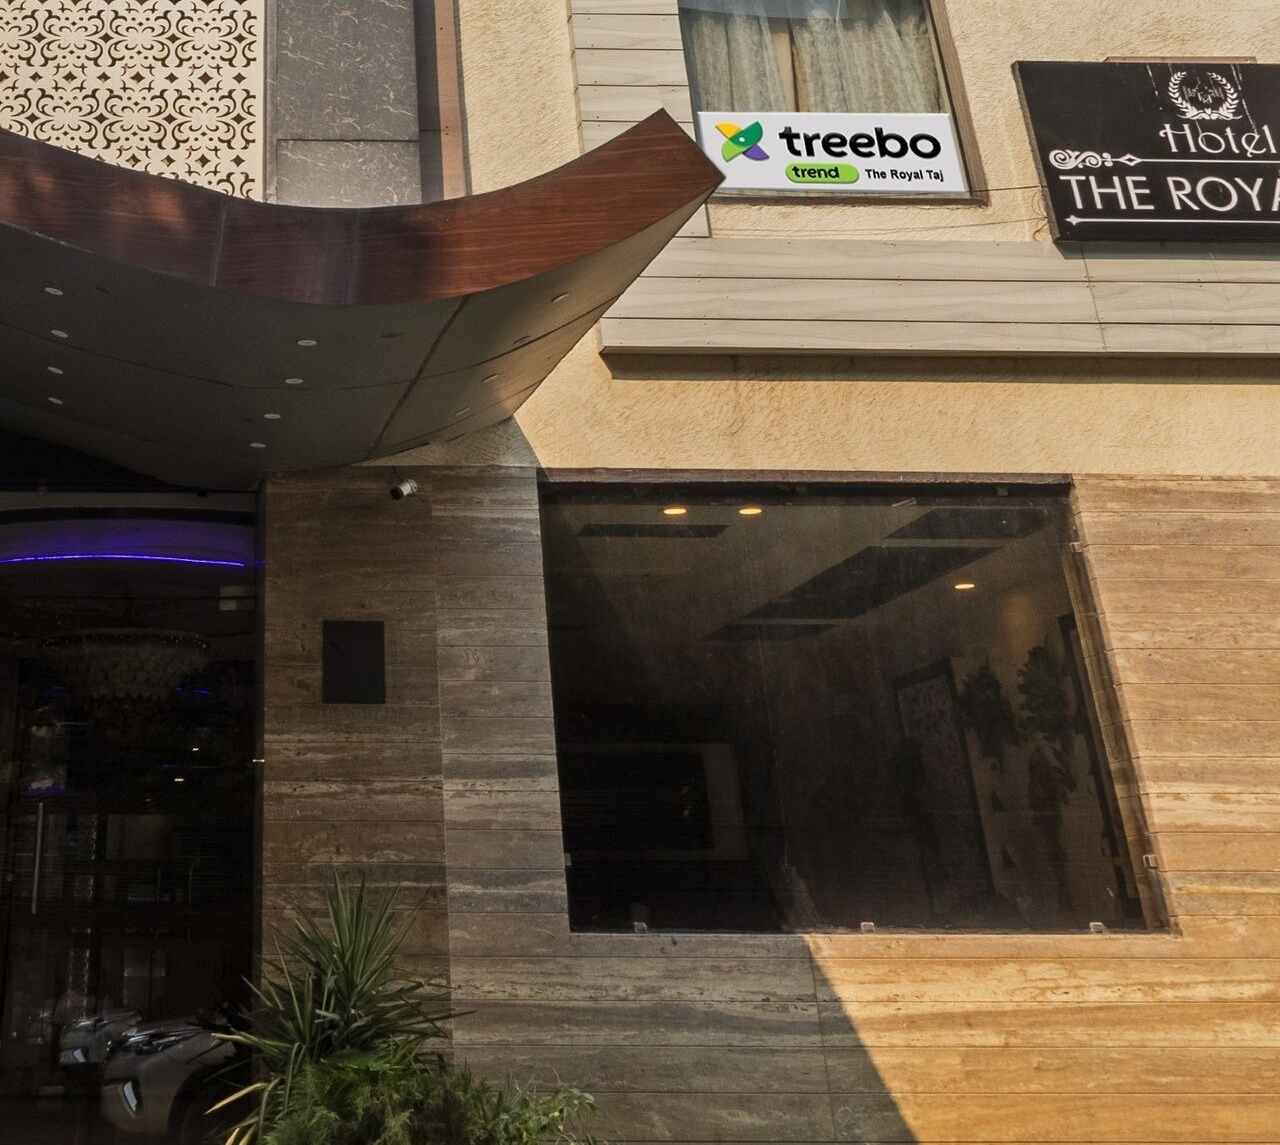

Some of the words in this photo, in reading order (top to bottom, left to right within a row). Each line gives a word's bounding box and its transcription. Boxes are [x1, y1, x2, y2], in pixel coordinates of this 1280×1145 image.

[778, 126, 942, 159] treebo
[1159, 123, 1278, 157] Hotel
[792, 165, 840, 179] trend
[865, 168, 887, 180] The
[891, 169, 924, 182] Royal
[926, 170, 944, 183] Taj
[1059, 175, 1155, 211] THE
